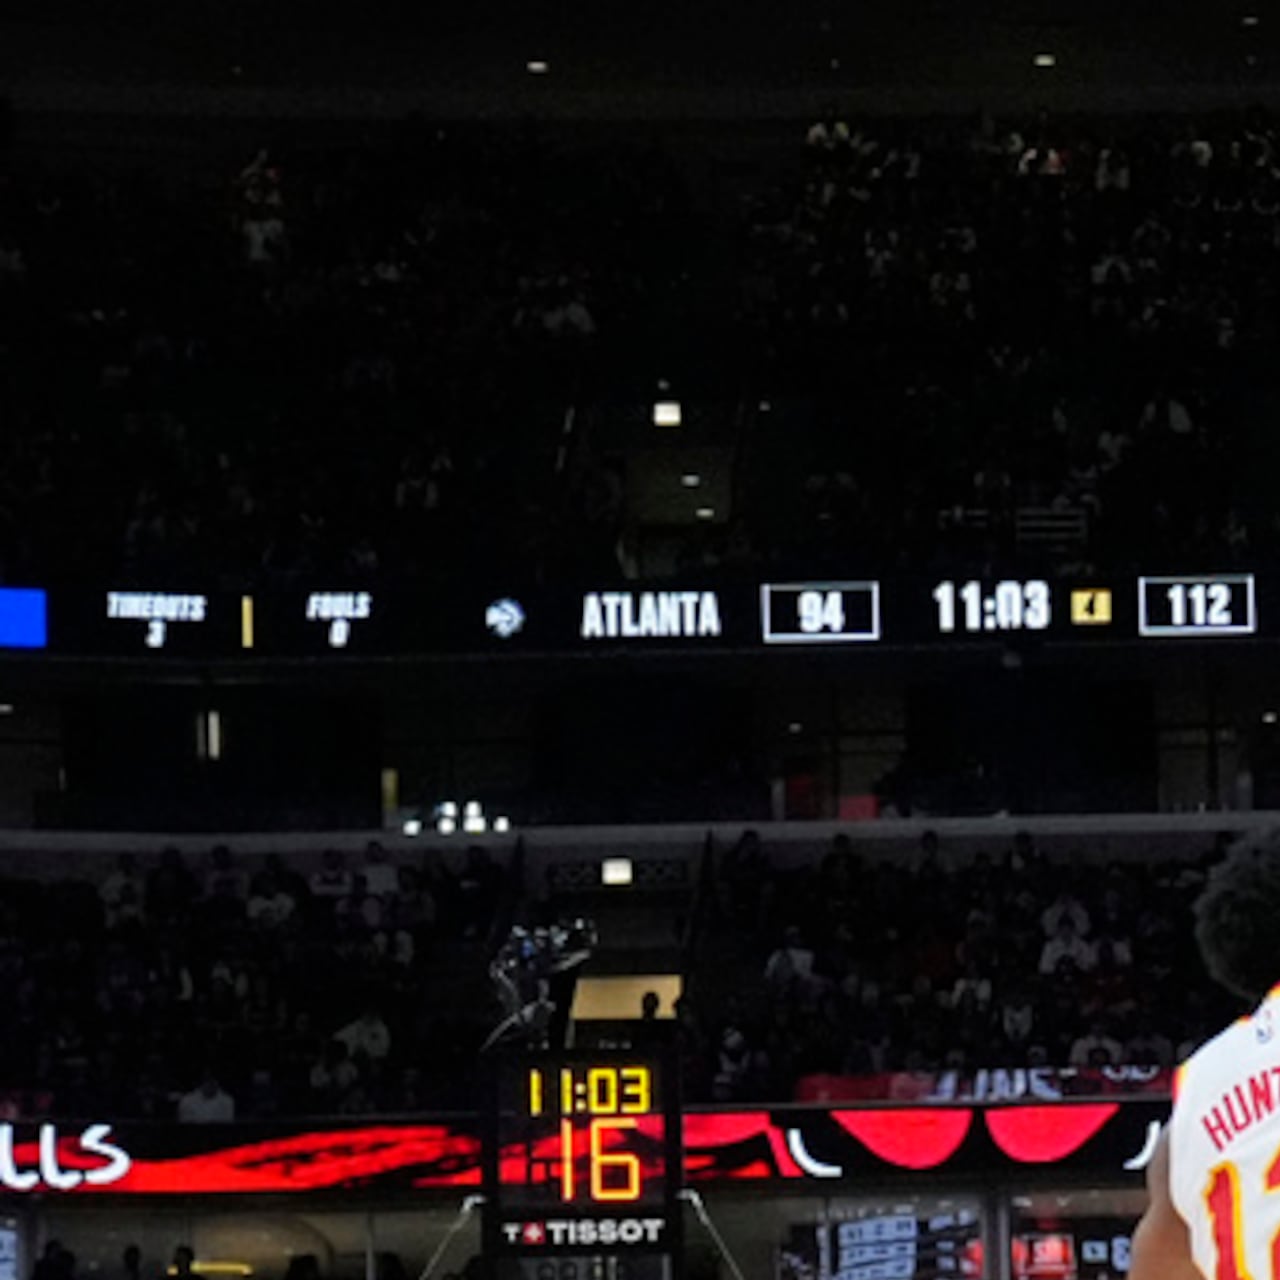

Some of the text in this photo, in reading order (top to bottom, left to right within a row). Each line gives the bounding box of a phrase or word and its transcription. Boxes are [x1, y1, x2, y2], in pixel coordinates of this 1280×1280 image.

[306, 591, 371, 620] FOULS
[581, 590, 721, 638] ATLANTA
[798, 591, 846, 632] 94
[934, 581, 1051, 632] 11:03
[1166, 584, 1233, 626] 112
[529, 1067, 652, 1118] 11:03
[560, 1117, 641, 1201] 16
[546, 1218, 666, 1244] TISSOT
